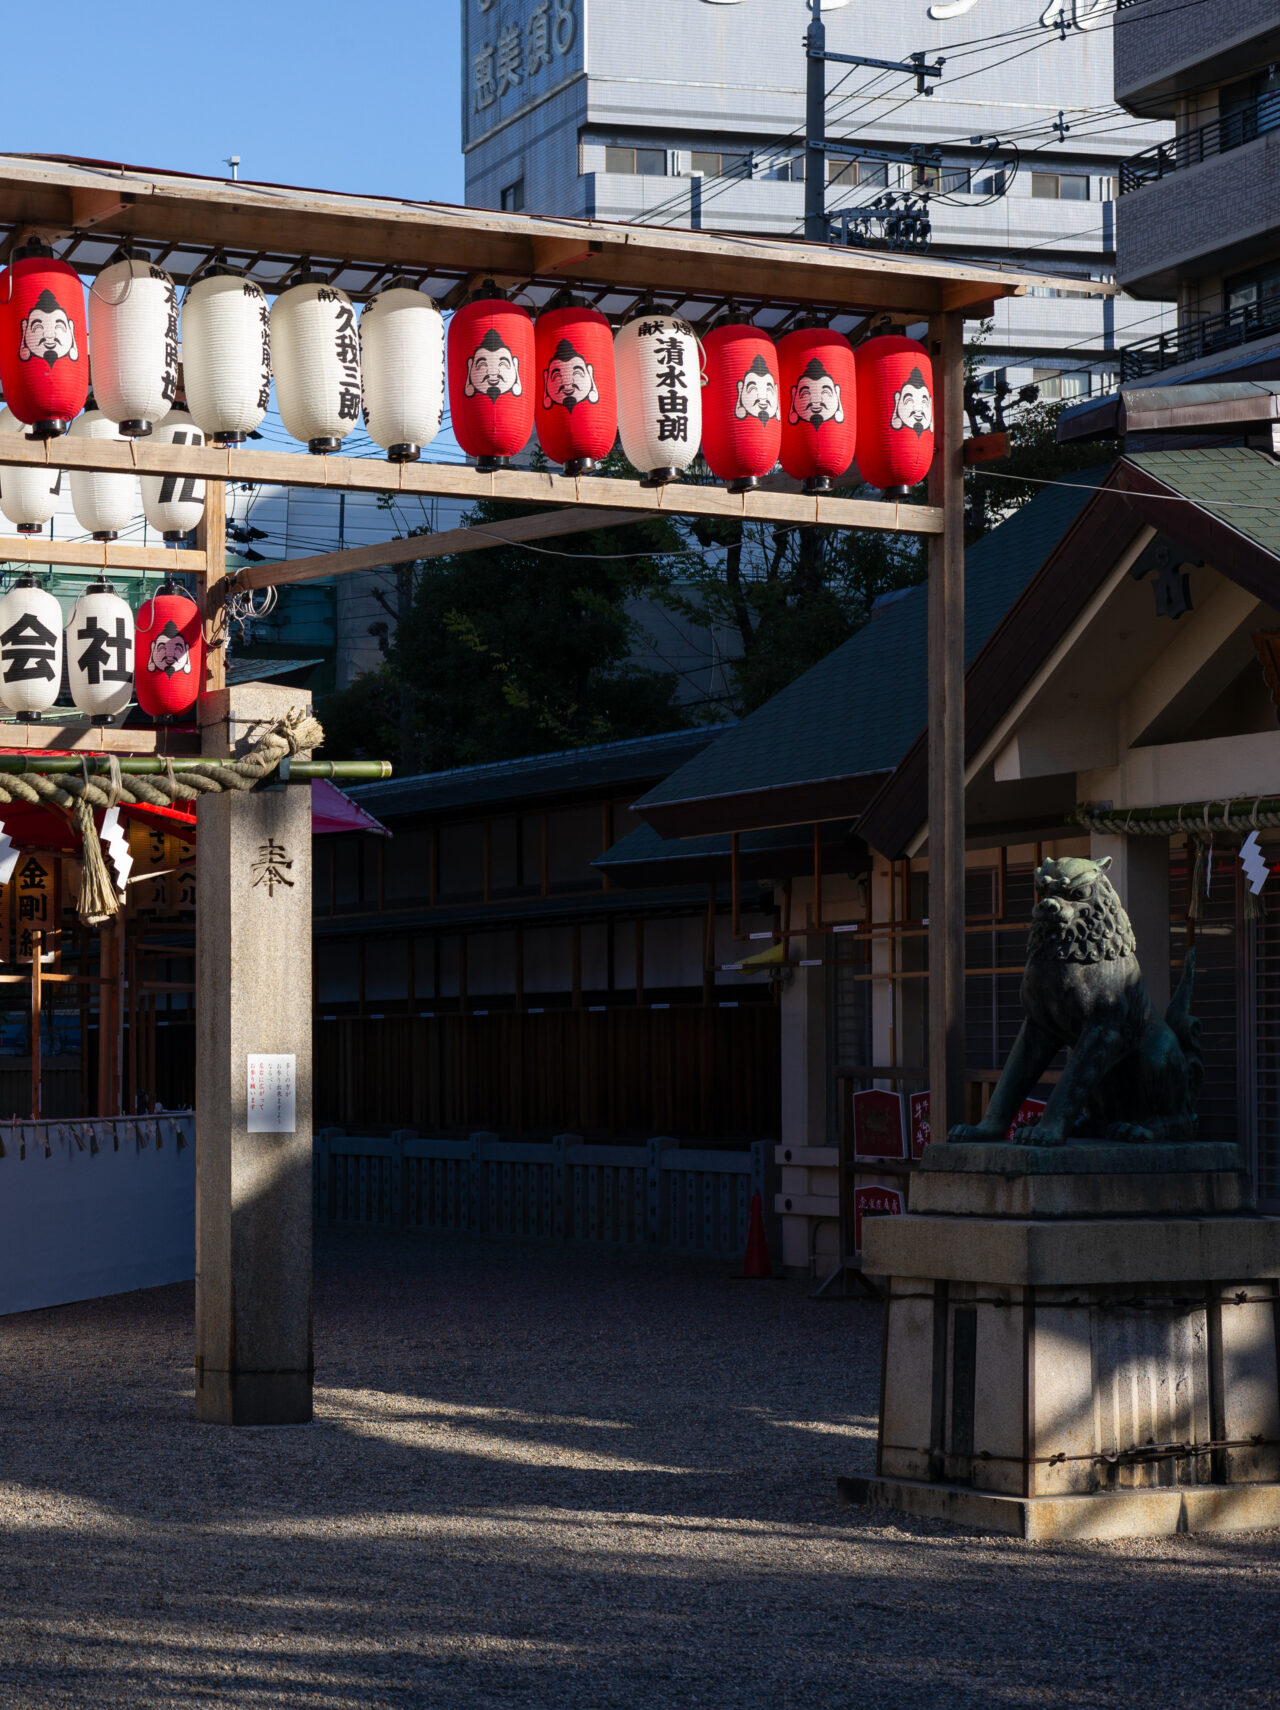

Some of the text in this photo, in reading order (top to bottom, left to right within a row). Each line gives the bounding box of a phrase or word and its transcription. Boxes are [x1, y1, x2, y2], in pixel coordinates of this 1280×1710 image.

[335, 305, 360, 421] 久我三郎
[653, 337, 688, 443] 清水由朗
[251, 838, 295, 897] 奉
